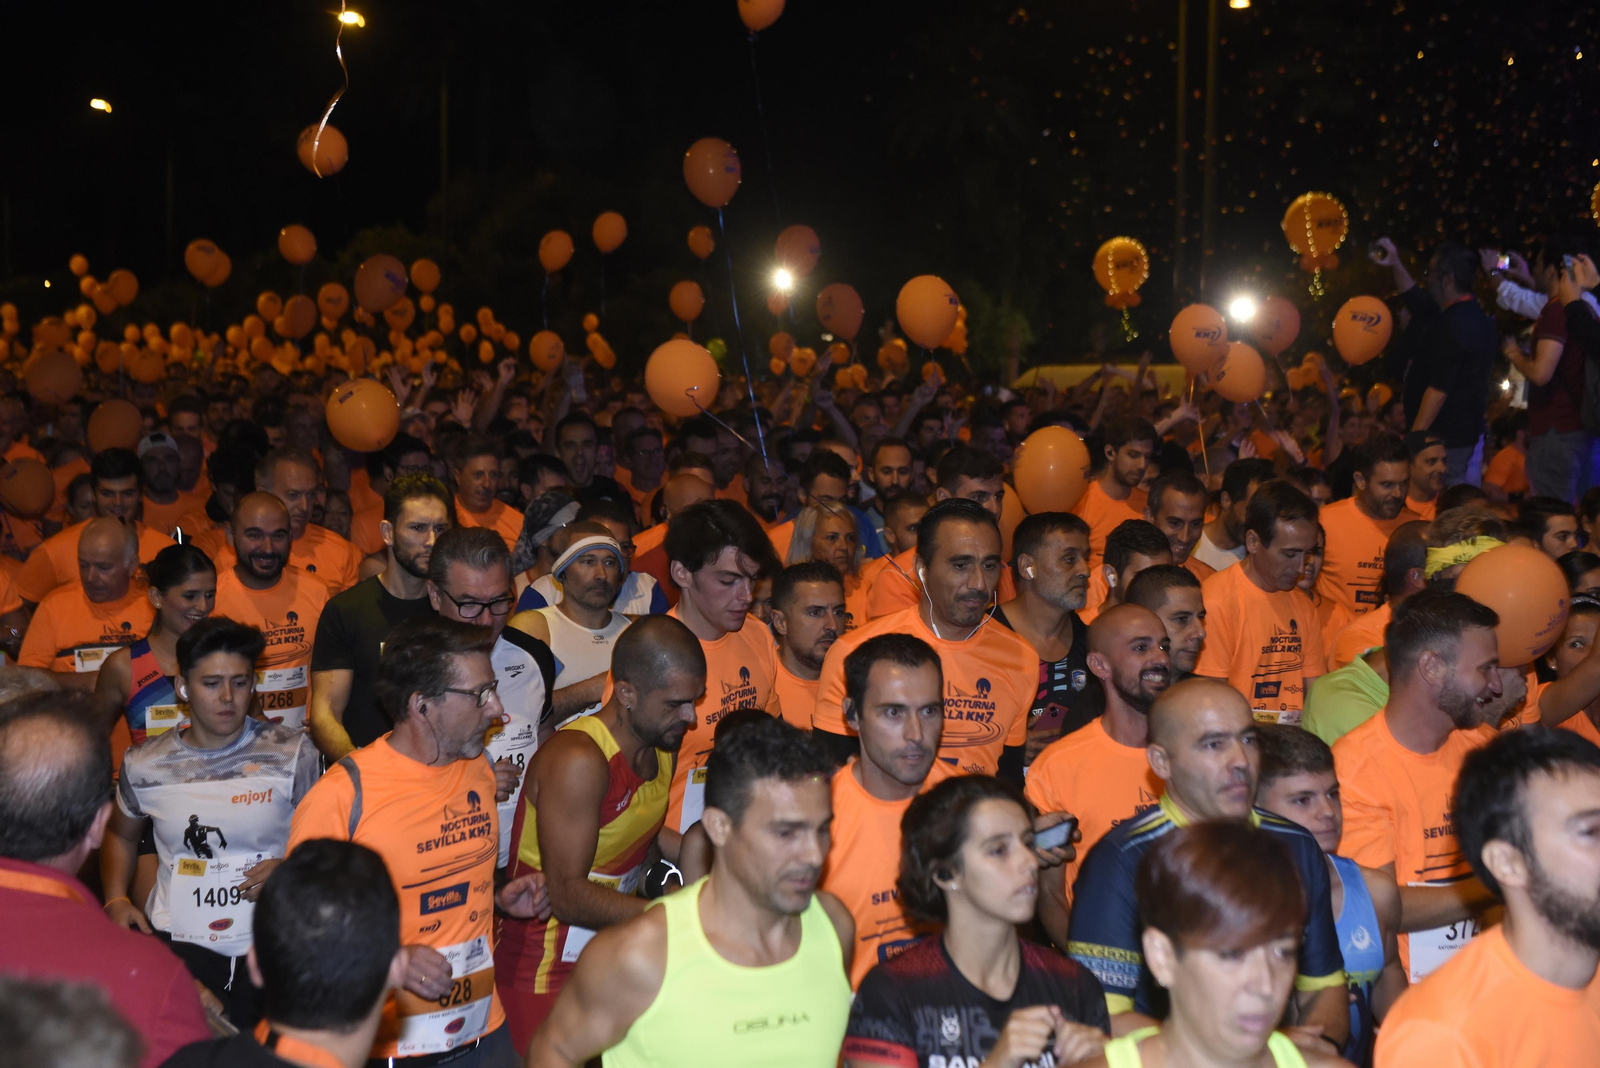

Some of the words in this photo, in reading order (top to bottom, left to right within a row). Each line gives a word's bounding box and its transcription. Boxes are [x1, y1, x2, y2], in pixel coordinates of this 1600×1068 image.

[1351, 313, 1376, 327] KH7
[284, 633, 306, 644] KH7
[504, 663, 526, 673] BROOKS
[259, 691, 295, 709] 1268
[720, 686, 758, 707] NOCTURNA
[738, 695, 758, 710] KH7
[966, 710, 995, 724] KH7
[231, 788, 274, 806] enjoy!
[440, 812, 491, 834] NOCTURNA
[416, 829, 467, 855] SEVILLA
[468, 822, 492, 840] KH7
[192, 885, 242, 909] 1409
